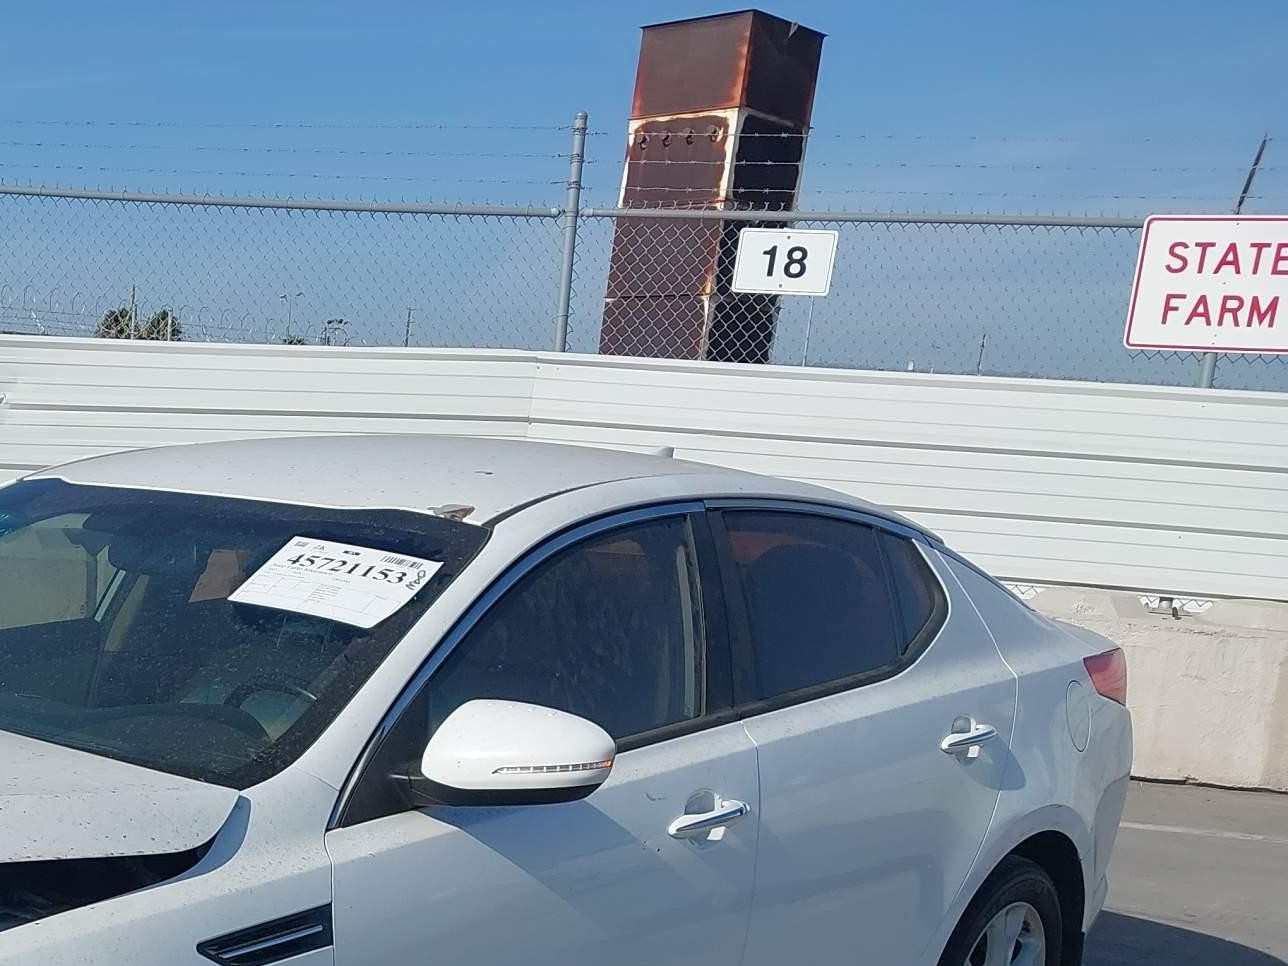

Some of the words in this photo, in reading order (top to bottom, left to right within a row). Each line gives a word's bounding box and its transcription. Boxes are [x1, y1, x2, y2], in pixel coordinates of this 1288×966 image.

[762, 244, 809, 279] 18
[1165, 241, 1288, 275] STATE
[1160, 293, 1280, 328] FARM
[287, 553, 407, 585] 45721153
